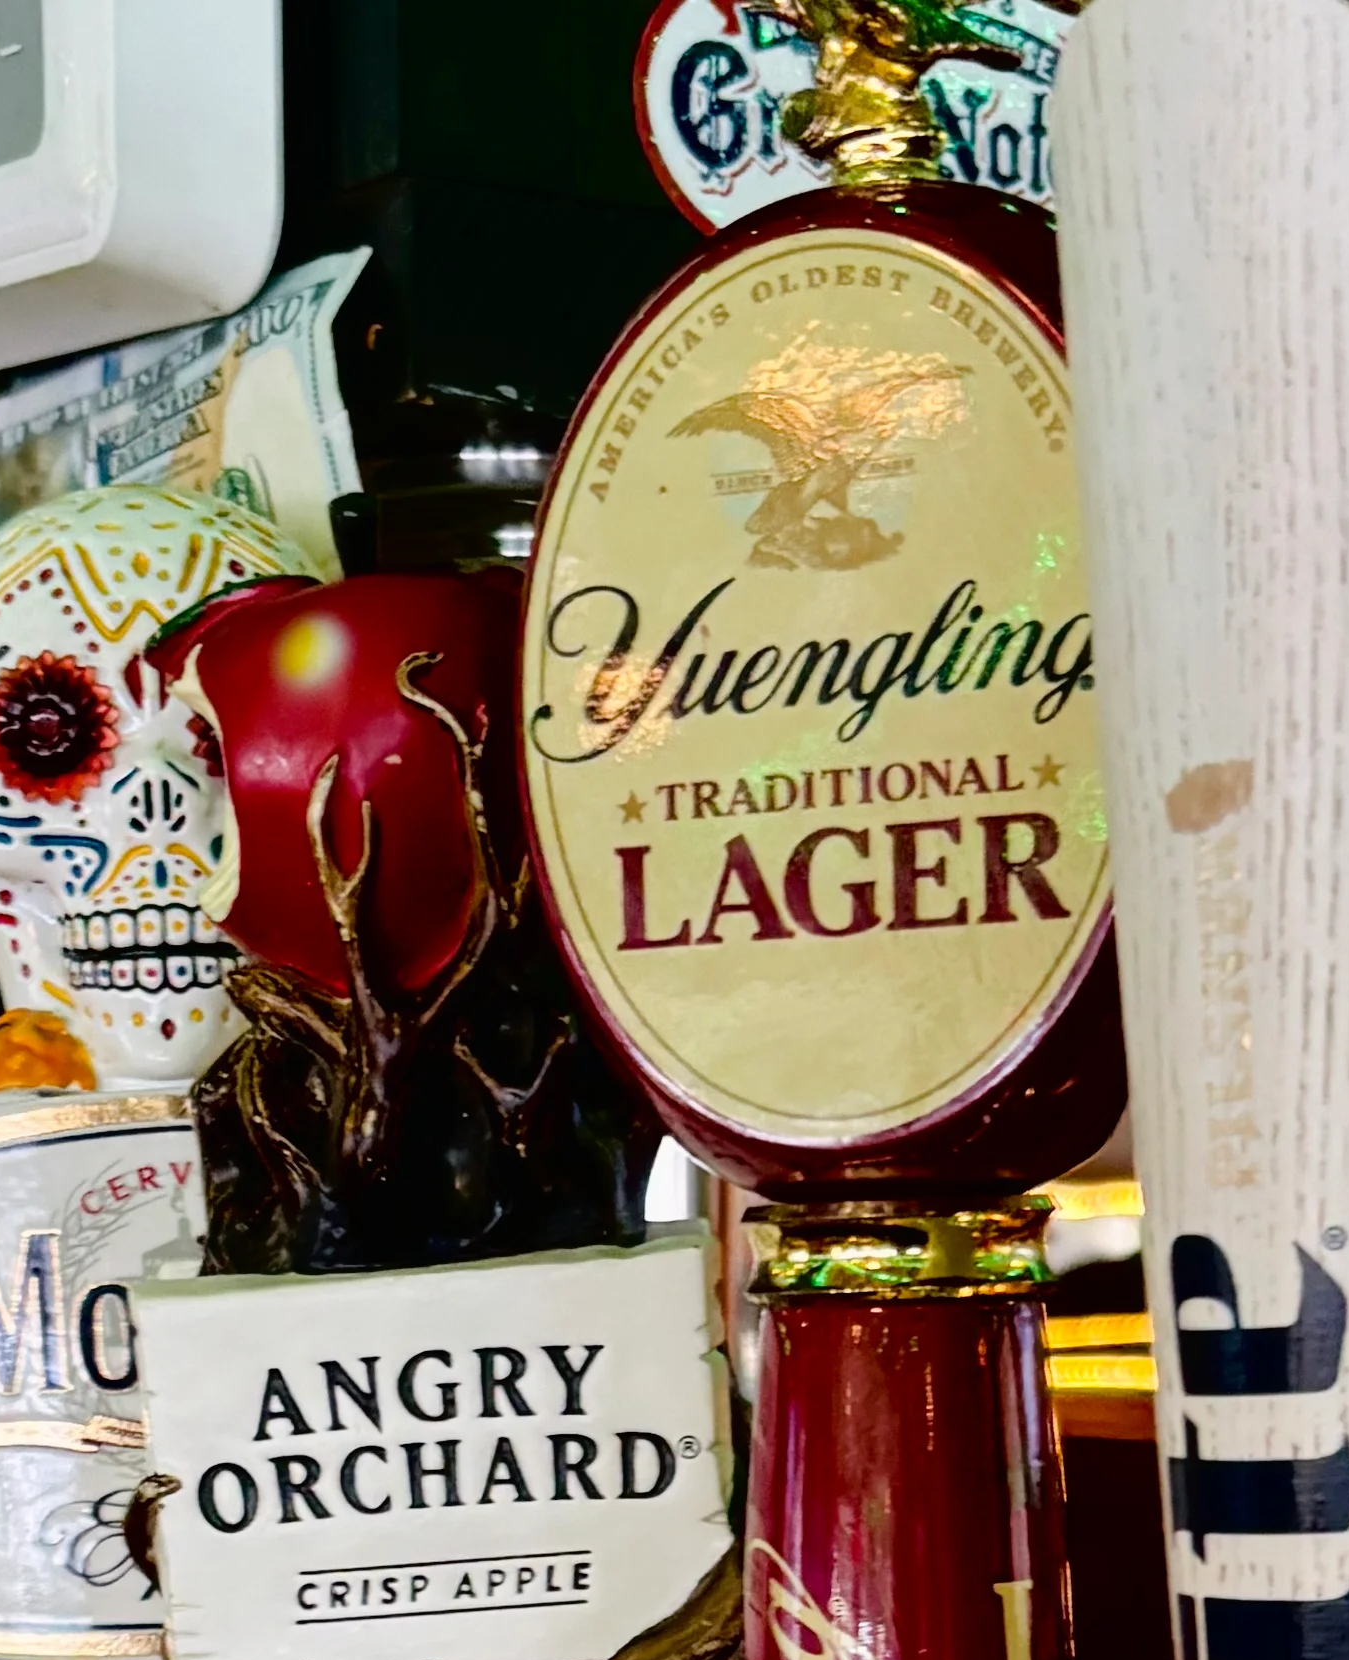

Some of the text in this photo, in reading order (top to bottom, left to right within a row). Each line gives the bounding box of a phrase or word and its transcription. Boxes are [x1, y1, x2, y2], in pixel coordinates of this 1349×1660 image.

[589, 301, 731, 503] AMERICA'S
[750, 264, 910, 306] OLDEST
[529, 577, 1095, 763] Yuengling
[655, 754, 1025, 821] TRADITIONAL
[612, 811, 1072, 951] LAGER
[79, 1160, 194, 1215] CERV
[253, 1345, 605, 1442] ANGRY
[197, 1430, 678, 1535] ORCHARD
[297, 1561, 593, 1611] CRISP APPLE
